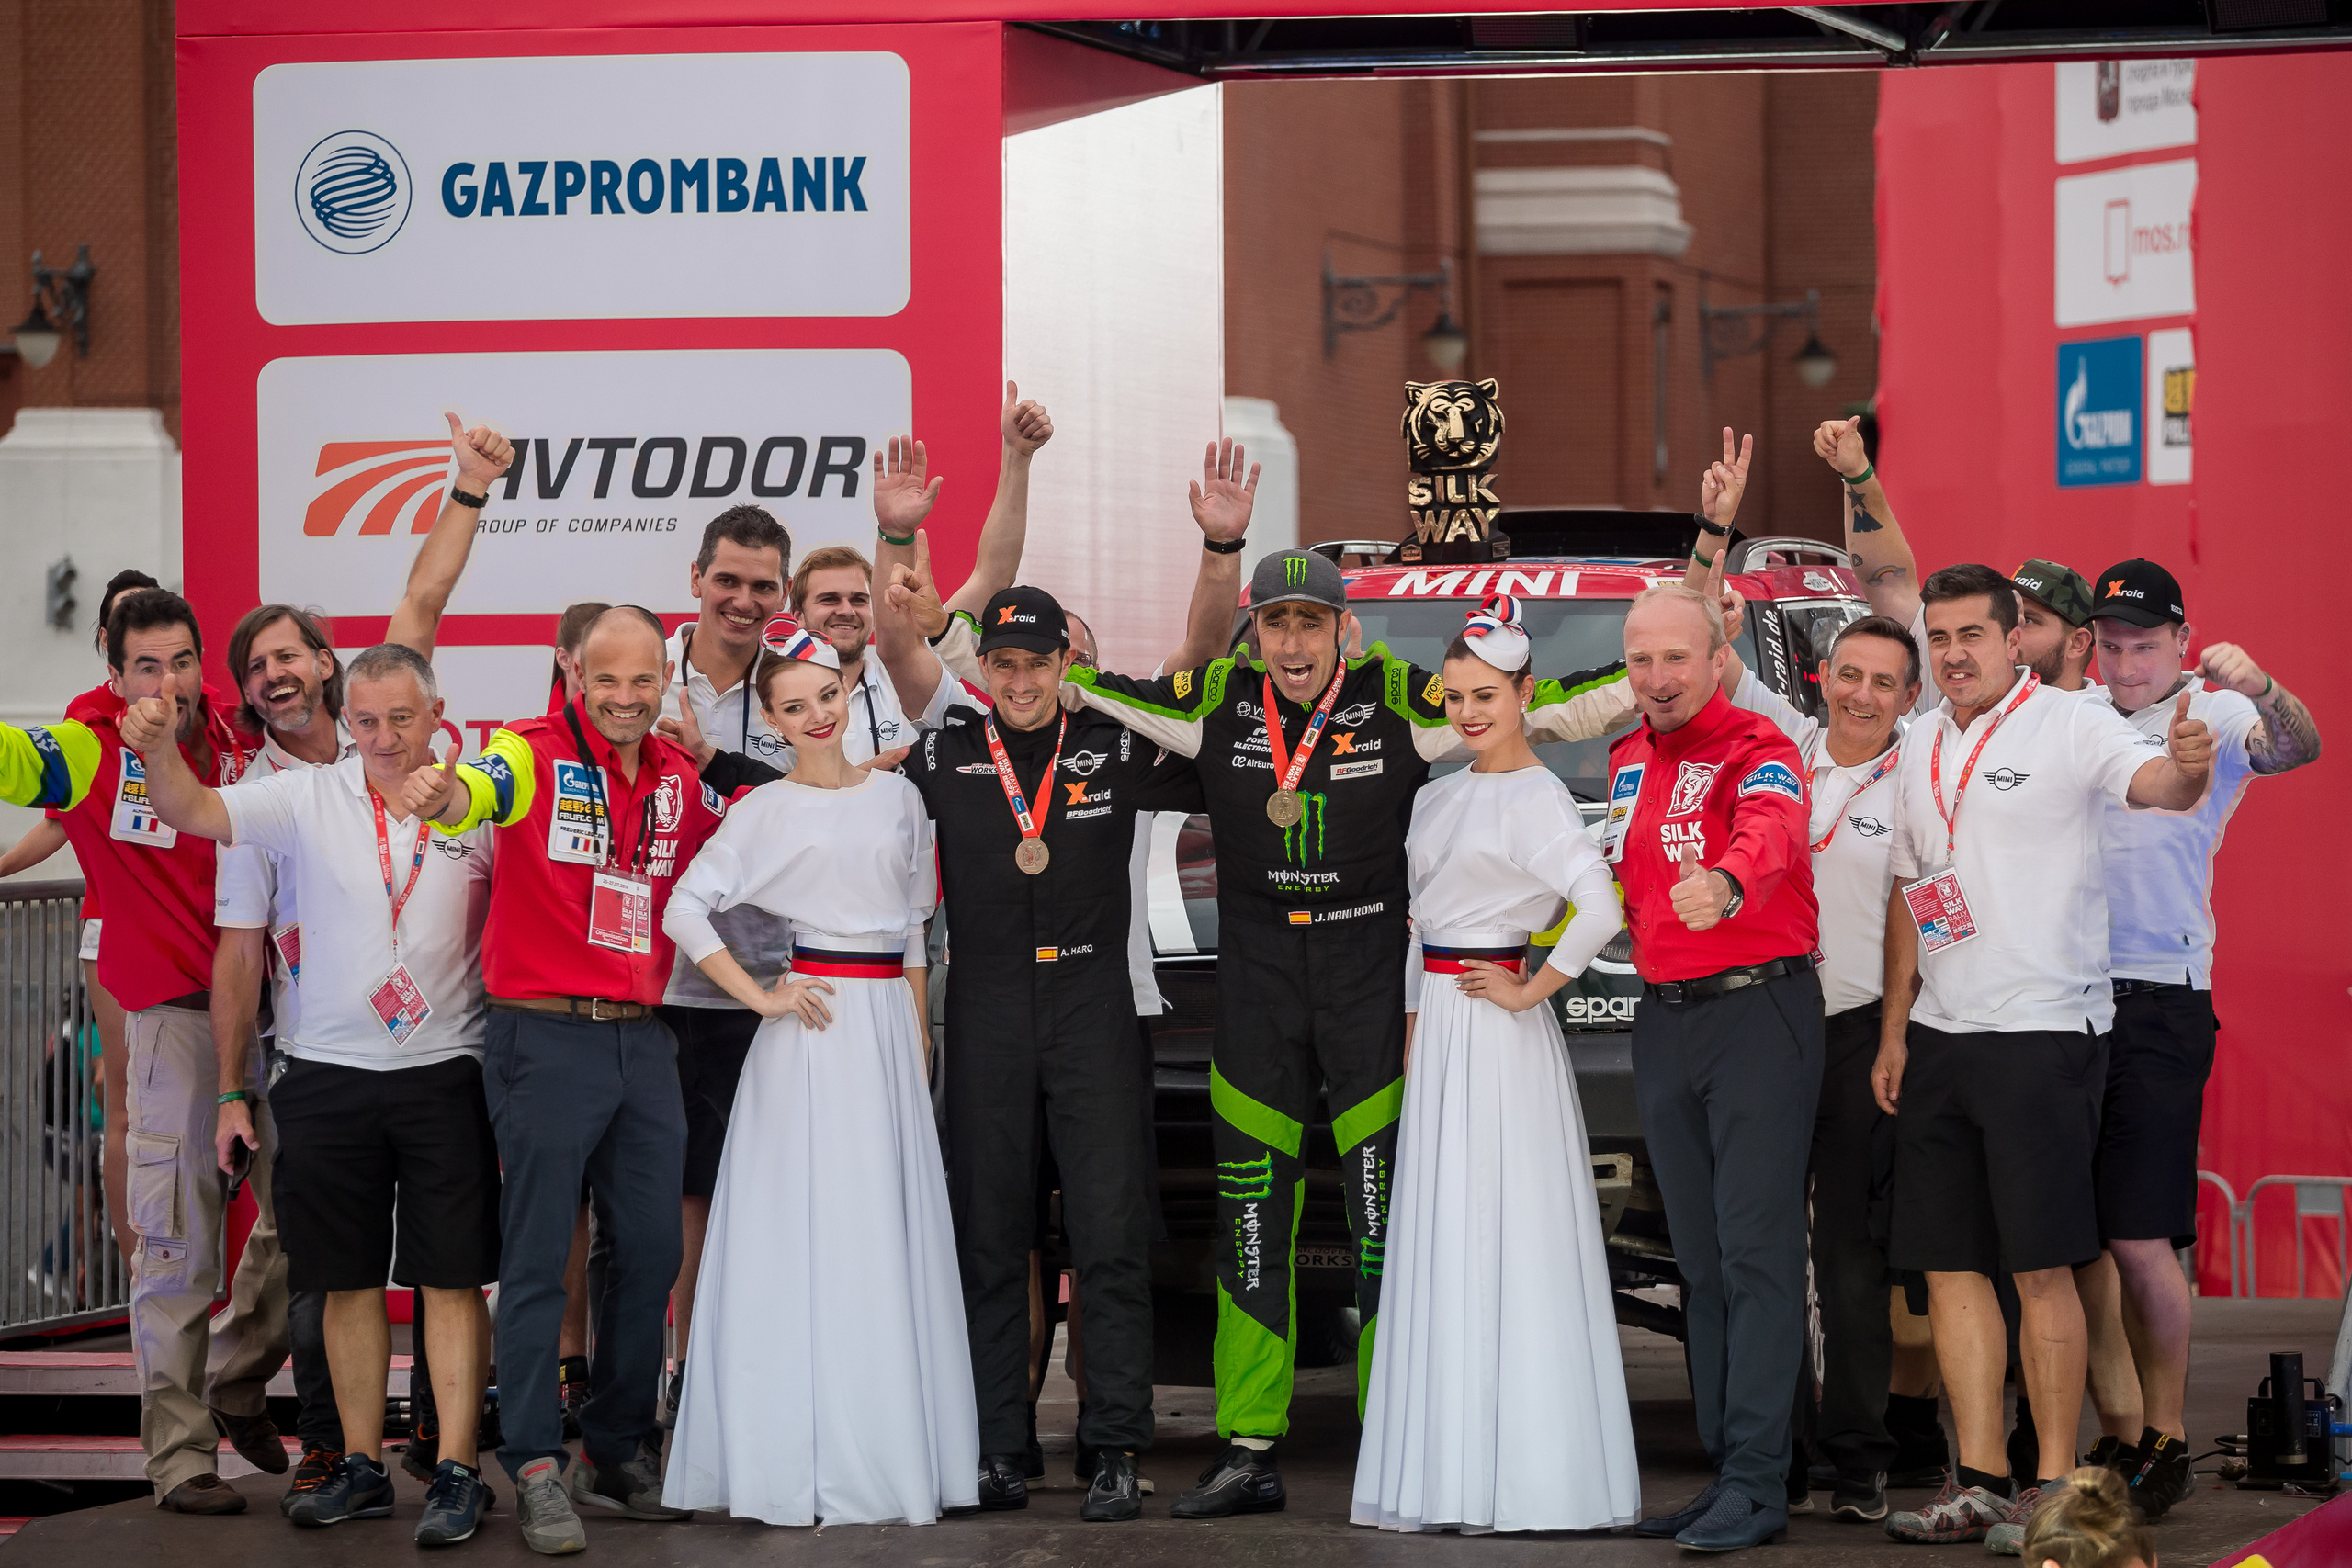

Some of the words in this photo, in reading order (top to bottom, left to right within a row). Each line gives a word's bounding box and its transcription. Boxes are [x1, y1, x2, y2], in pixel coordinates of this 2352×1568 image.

[441, 155, 868, 218] GAZPROMBANK
[1408, 473, 1500, 506] SILK
[472, 517, 527, 533] ROUP
[535, 517, 560, 532] OF
[568, 517, 678, 533] COMPANIES
[1409, 507, 1500, 543] WAY
[1388, 570, 1580, 596] MINI
[2105, 580, 2145, 599] X-raid
[997, 605, 1036, 625] X-raid
[1209, 664, 1224, 702] sparco
[1390, 668, 1402, 705] sparco
[1345, 710, 1363, 720] MINI
[761, 740, 775, 750] MINI
[926, 731, 937, 772] sparco
[1233, 741, 1272, 753] ELECTRON
[1330, 732, 1382, 756] X-raid
[970, 766, 999, 774] WORKS
[997, 760, 1007, 775] WAY
[1001, 758, 1013, 774] SILK
[1076, 758, 1094, 768] MINI
[1247, 759, 1275, 770] AirEuro
[1336, 762, 1379, 776] BFGoodrich
[1285, 764, 1296, 781] WAY
[1292, 766, 1304, 783] SILK
[1745, 772, 1776, 785] SILK
[1777, 773, 1798, 787] WAY
[1008, 773, 1021, 795] RALLY
[1064, 781, 1112, 806] X-raid
[559, 812, 605, 825] FBLIFE.CM
[1066, 805, 1113, 820] BFGoodrich
[560, 825, 584, 835] FREDERIC
[1659, 820, 1706, 843] SILK
[1860, 821, 1877, 831] MINI
[447, 845, 461, 853] MINI
[650, 840, 679, 858] SILK
[1662, 840, 1706, 863] WY
[649, 859, 675, 877] WAY
[1267, 869, 1340, 886] MONSTER
[1277, 884, 1330, 892] ENERGY
[1942, 897, 1963, 910] SILK
[1945, 903, 1964, 916] WAY
[1314, 913, 1326, 923] J.
[1326, 908, 1352, 921] NANI
[1353, 902, 1384, 918] ROMA
[1948, 909, 1968, 921] RALLY
[595, 929, 629, 942] Organisation
[1060, 948, 1069, 957] A.
[1070, 944, 1093, 955] HARO
[1566, 997, 1642, 1024] spar
[1363, 1145, 1381, 1236] MONSTER
[1379, 1158, 1388, 1224] ENERGY
[1242, 1202, 1261, 1292] MONSTER
[1295, 1254, 1352, 1266] ORKS
